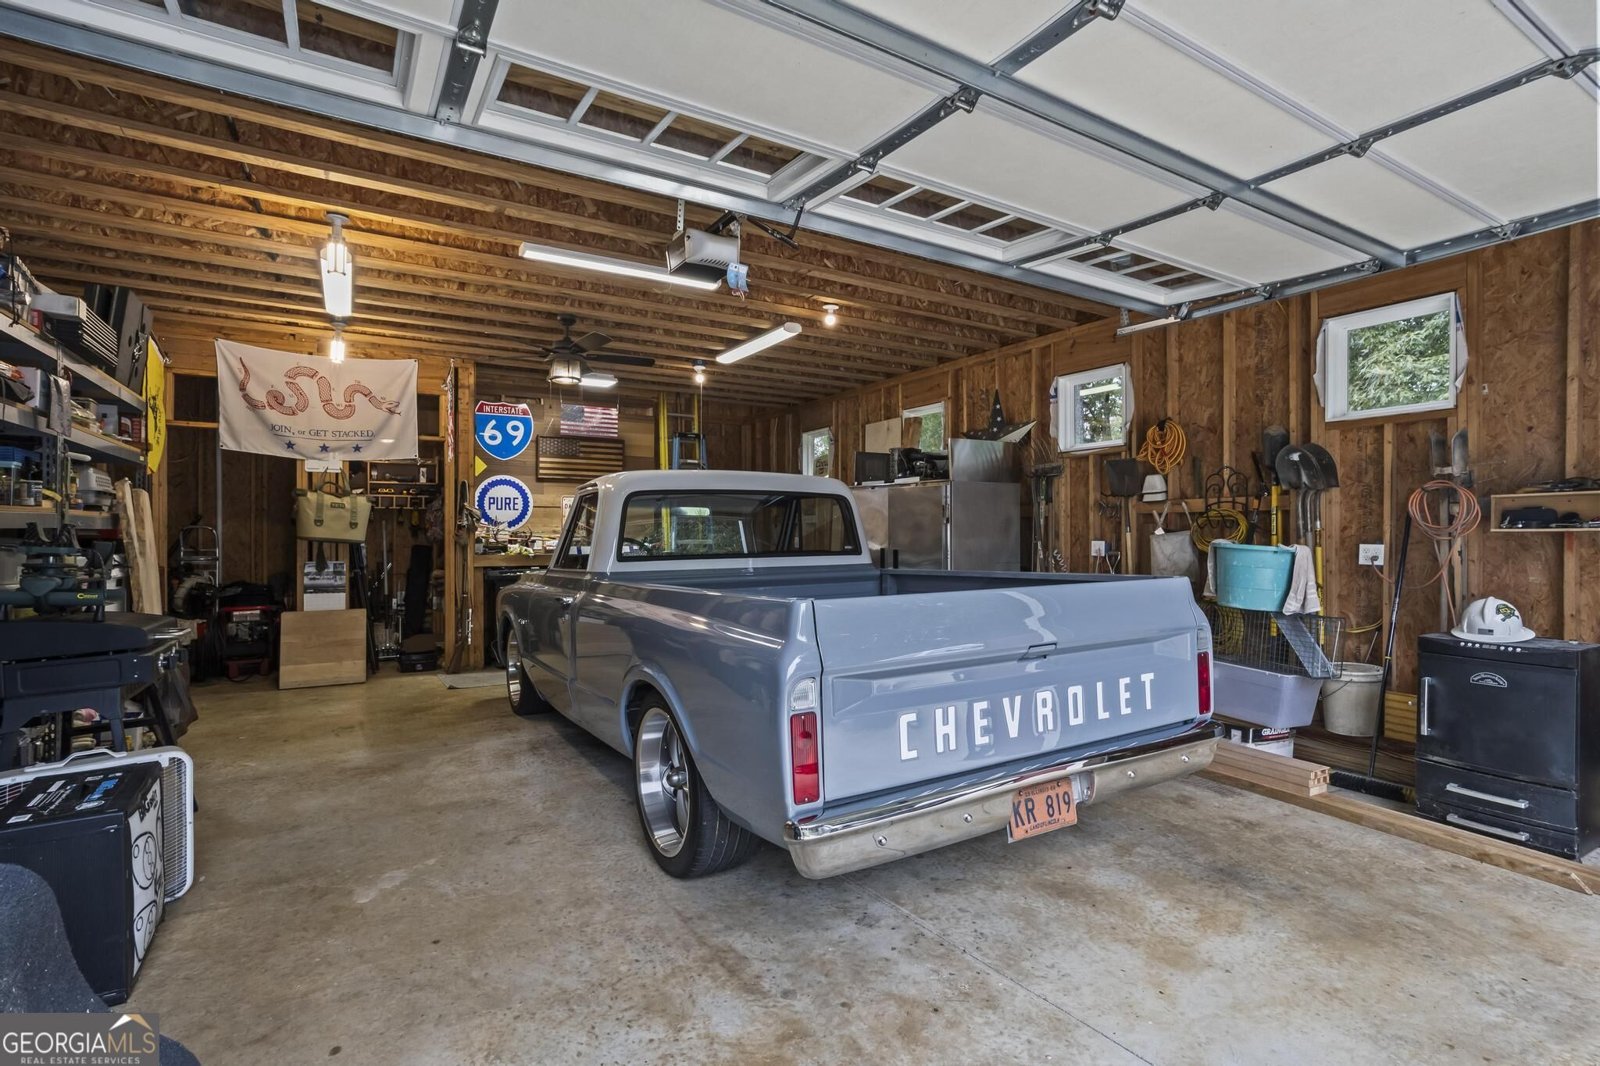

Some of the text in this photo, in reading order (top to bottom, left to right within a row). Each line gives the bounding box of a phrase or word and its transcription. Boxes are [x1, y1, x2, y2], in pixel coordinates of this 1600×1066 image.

[483, 405, 524, 415] INTERSTATE
[270, 424, 295, 435] JOIN,
[309, 429, 329, 437] GET
[483, 419, 525, 446] 69
[488, 497, 519, 511] PURE
[899, 672, 1155, 761] CHEVROLET
[1012, 791, 1071, 828] KR 819
